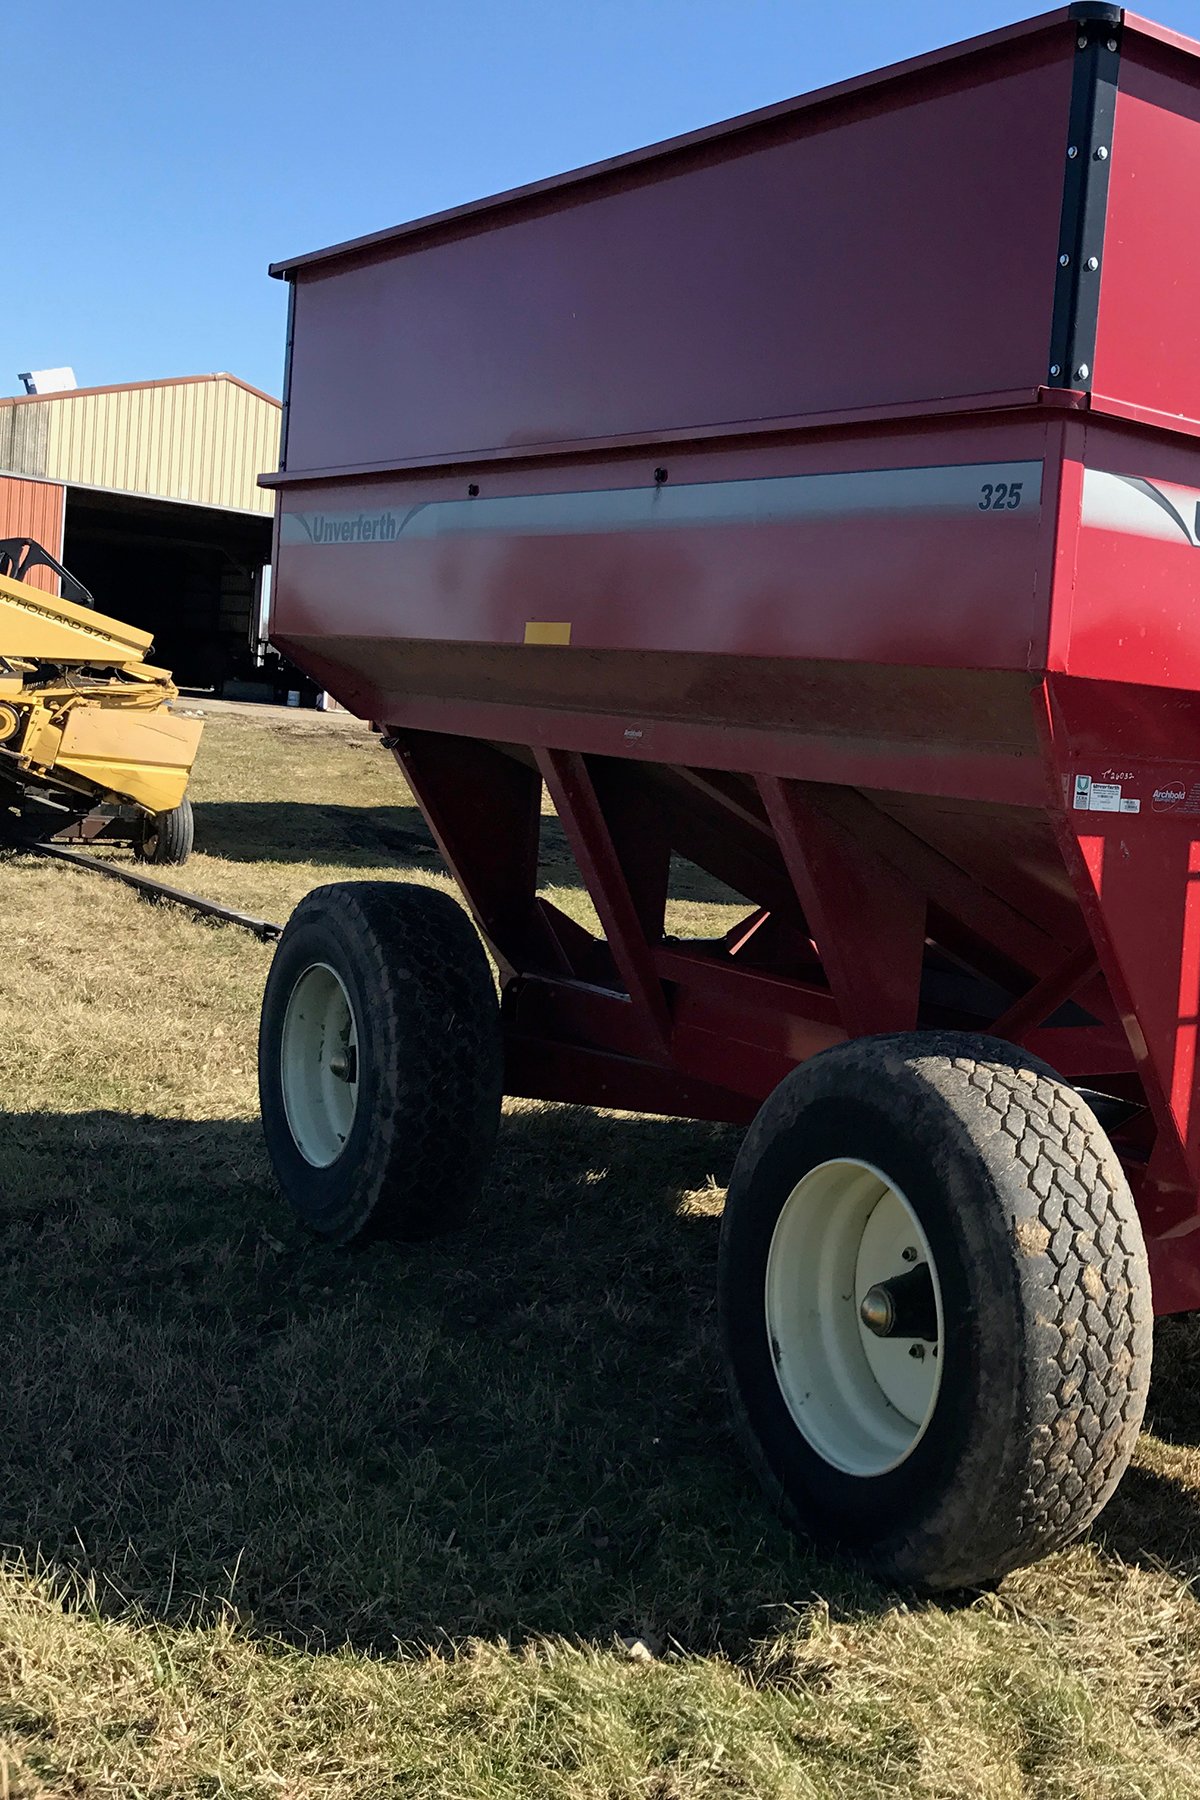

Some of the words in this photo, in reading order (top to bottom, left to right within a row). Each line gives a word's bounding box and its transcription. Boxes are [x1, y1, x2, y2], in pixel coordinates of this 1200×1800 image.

[978, 482, 1024, 511] 325
[313, 511, 397, 542] Unverferth
[16, 599, 81, 630] HOLLAND
[82, 625, 112, 642] 973
[1152, 789, 1186, 800] Archbold
